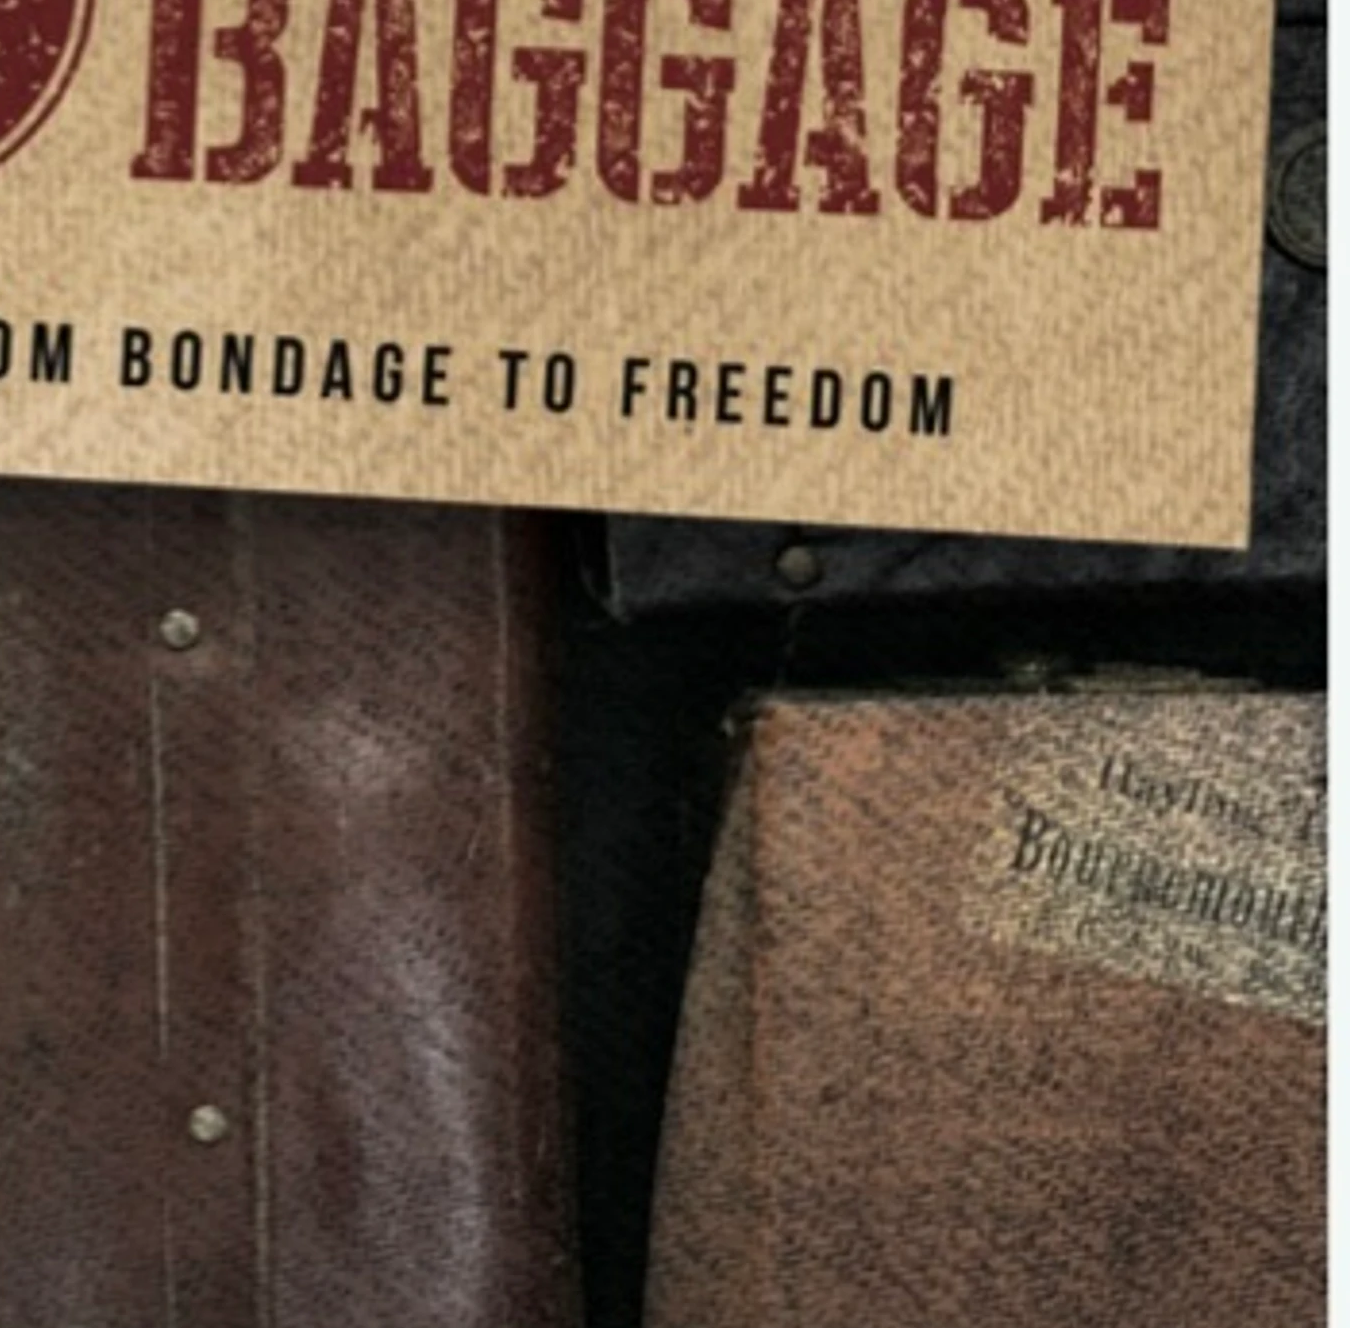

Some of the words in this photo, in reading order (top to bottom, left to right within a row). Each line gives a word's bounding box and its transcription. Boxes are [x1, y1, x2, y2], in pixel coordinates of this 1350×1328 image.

[119, 326, 453, 407] BONDAGE
[498, 348, 576, 415] TO
[620, 356, 954, 437] FREEDOM
